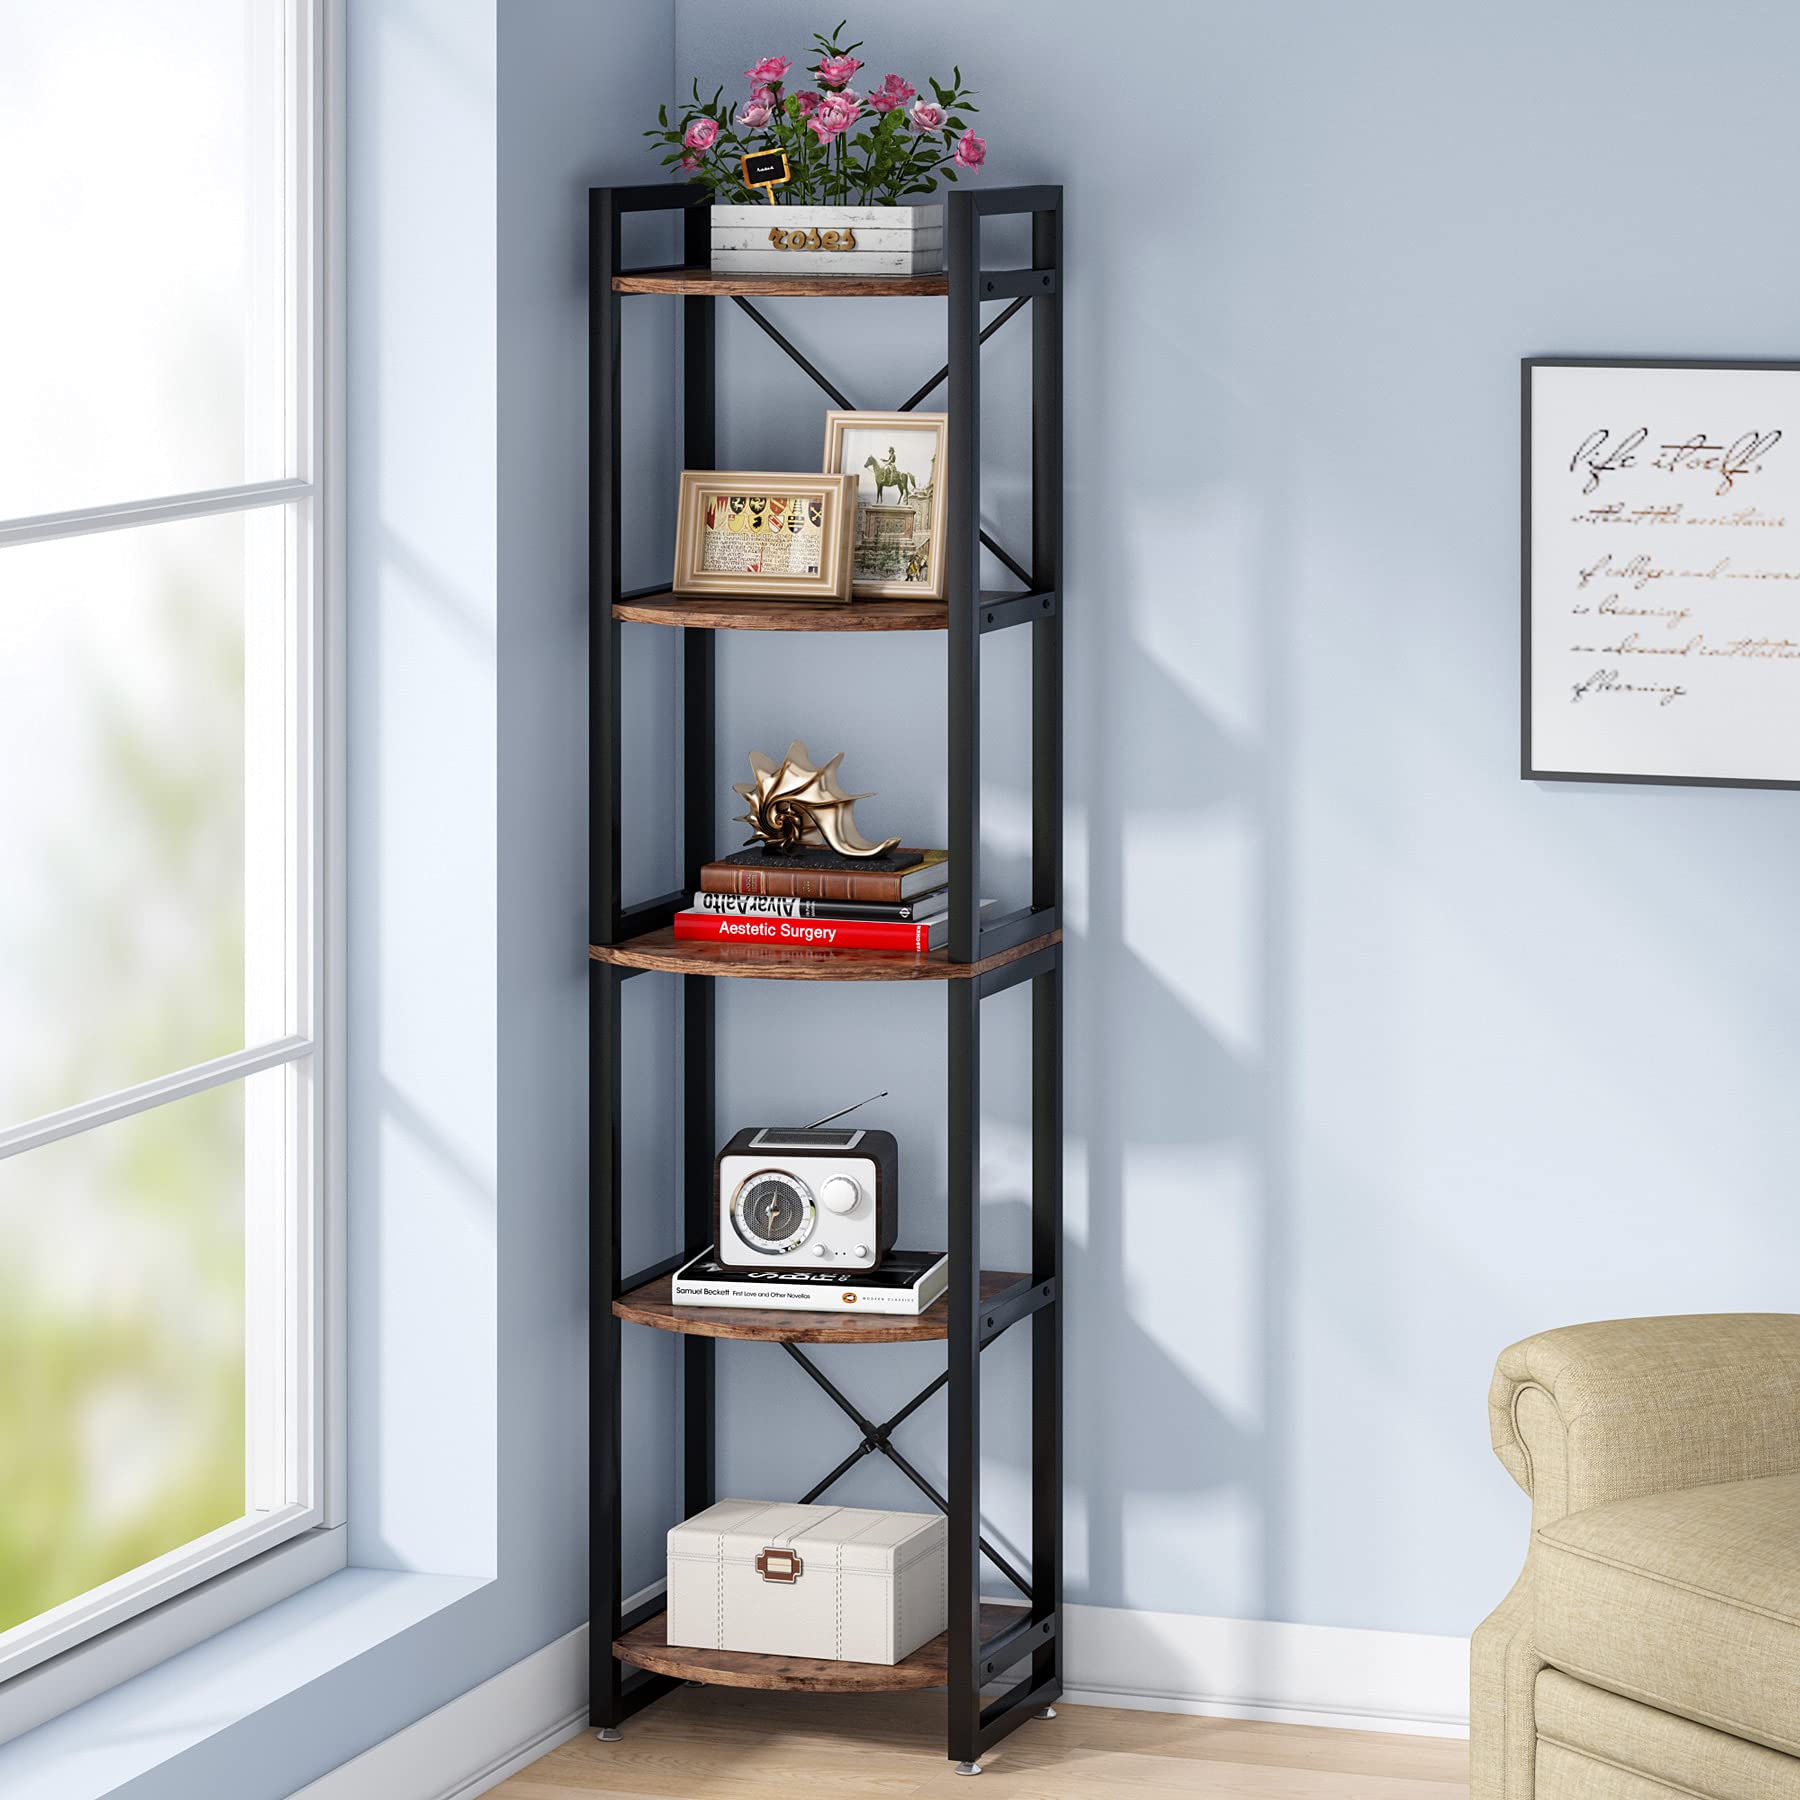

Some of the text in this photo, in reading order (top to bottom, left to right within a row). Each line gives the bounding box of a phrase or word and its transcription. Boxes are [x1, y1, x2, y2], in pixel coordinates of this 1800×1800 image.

[768, 226, 856, 251] roses
[719, 920, 837, 943] Aestetic Surgery
[676, 1286, 703, 1295] Samuel
[703, 1288, 730, 1296] Beckett
